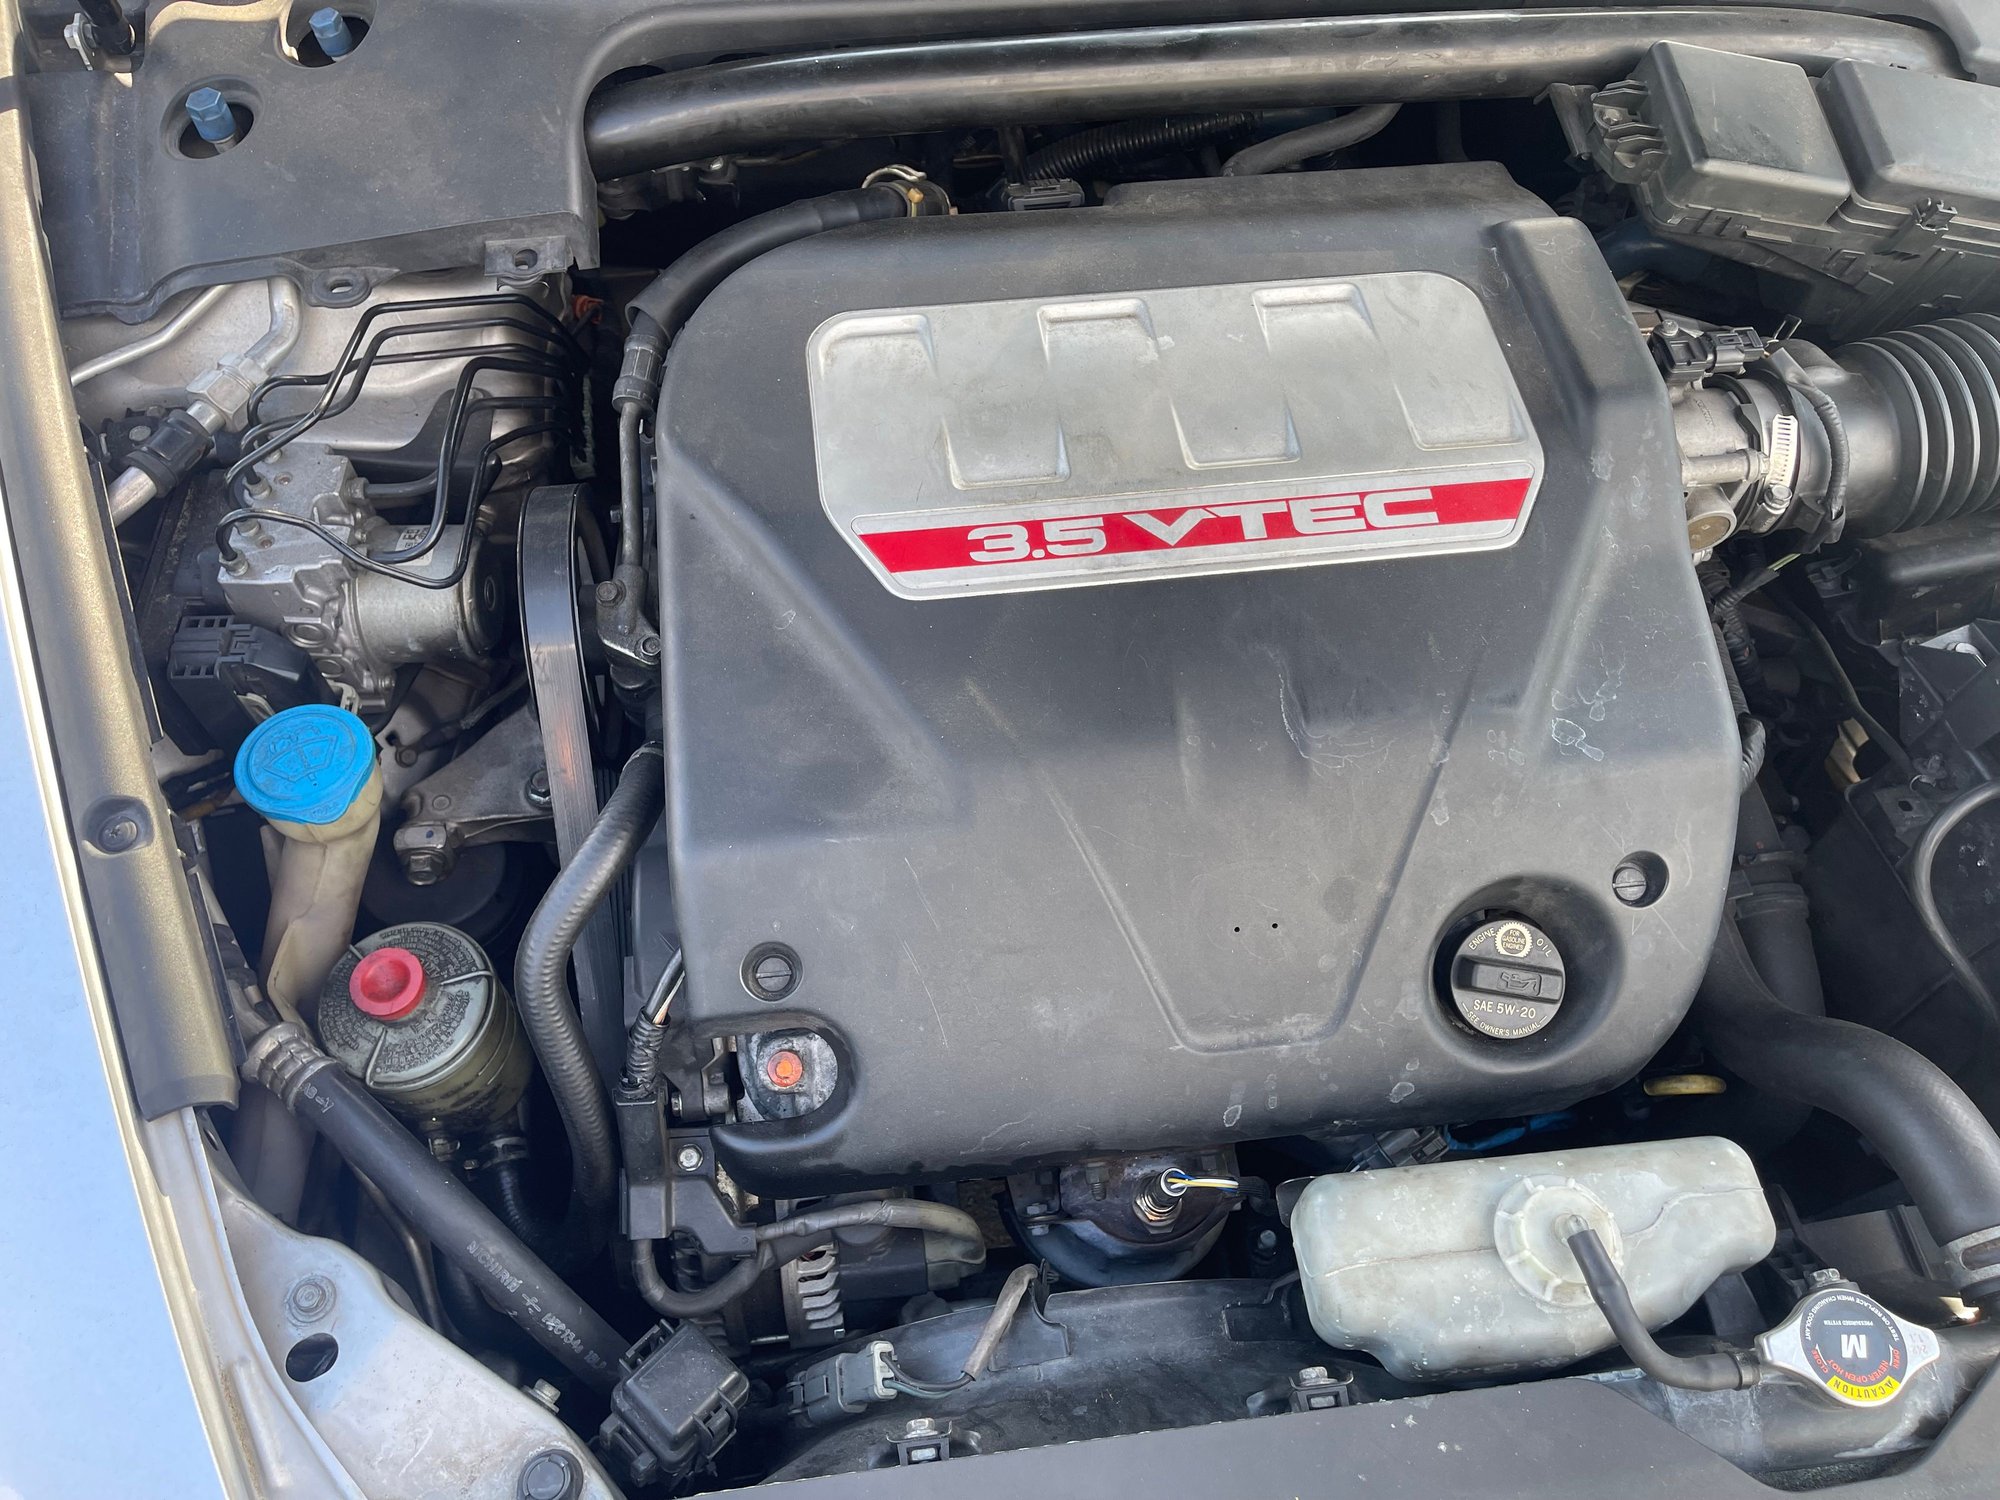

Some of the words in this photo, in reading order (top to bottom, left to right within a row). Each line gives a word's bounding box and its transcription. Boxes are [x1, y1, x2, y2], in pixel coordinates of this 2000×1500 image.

[967, 517, 1107, 563] 3.5
[1122, 488, 1439, 546] VTEC
[1468, 927, 1496, 950] ENGINE
[1536, 938, 1553, 957] OIL
[1502, 934, 1526, 945] GASOLINE
[1502, 941, 1524, 950] ENGINES
[1473, 999, 1493, 1012] SAE
[1496, 1003, 1536, 1019] 5W-20
[1467, 1010, 1480, 1024] SEE
[1480, 1021, 1510, 1036] OWNER'S
[1512, 1021, 1541, 1036] MANUAL
[1836, 1294, 1855, 1302] WHEN
[1855, 1297, 1883, 1318] REPLACE
[1804, 1312, 1815, 1341] COOLANT
[1881, 1315, 1891, 1326] OR
[1888, 1326, 1900, 1341] TEST
[1840, 1334, 1867, 1359] M
[1811, 1349, 1829, 1374] CLOSE
[1827, 1359, 1845, 1375] HOT
[1868, 1359, 1889, 1381] NEVER
[1844, 1371, 1868, 1383] OPEN
[1833, 1379, 1887, 1399] CAUTION
